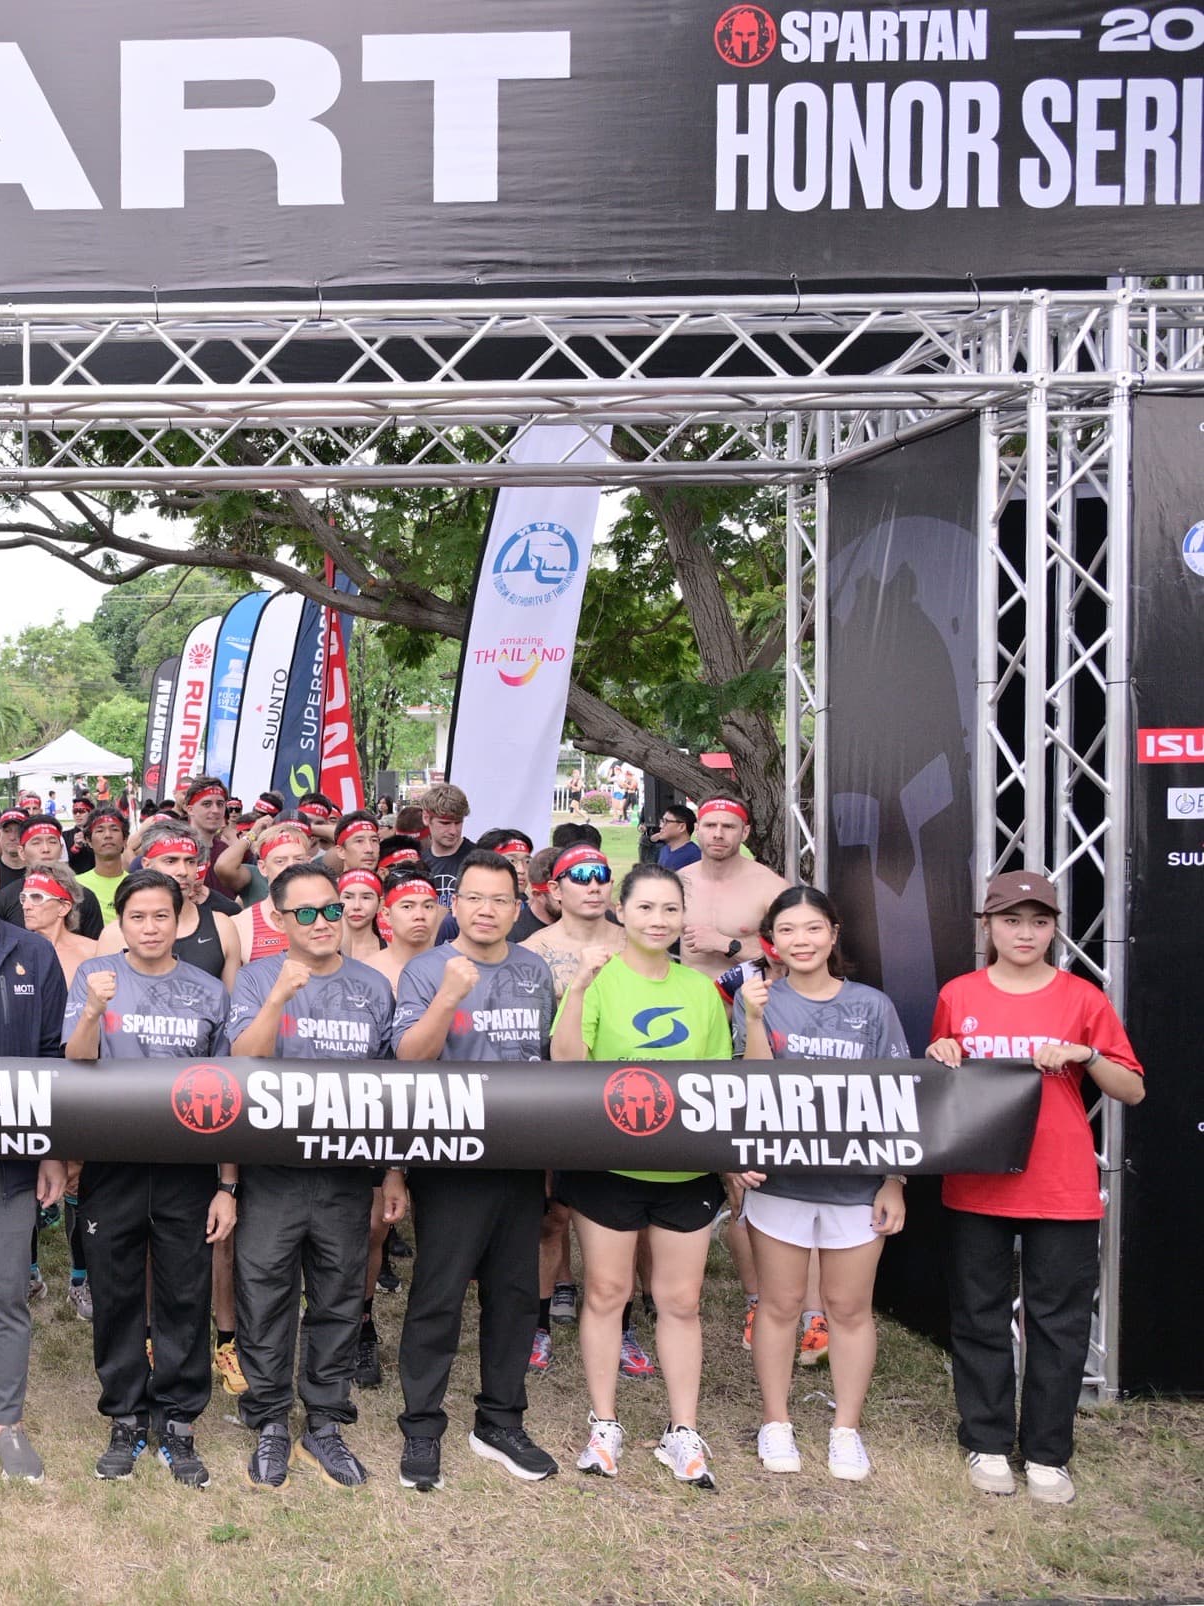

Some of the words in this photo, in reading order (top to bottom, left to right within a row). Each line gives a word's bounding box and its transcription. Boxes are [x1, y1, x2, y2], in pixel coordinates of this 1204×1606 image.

[780, 9, 988, 63] SPARTAN
[715, 80, 1000, 213] HONOR
[499, 635, 544, 647] amazing
[473, 647, 566, 665] THAILAND
[262, 668, 288, 751] SUUNTO
[122, 1013, 199, 1038] SPARTAN
[297, 1017, 371, 1043] SPARTAN
[138, 1034, 198, 1048] THAILAND
[313, 1040, 369, 1054] THAILAND
[787, 1034, 865, 1060] SPARTAN
[246, 1070, 486, 1131] SPARTAN
[677, 1073, 921, 1134] SPARTAN
[296, 1135, 486, 1162] THAILAND
[732, 1138, 924, 1167] THAILAND
